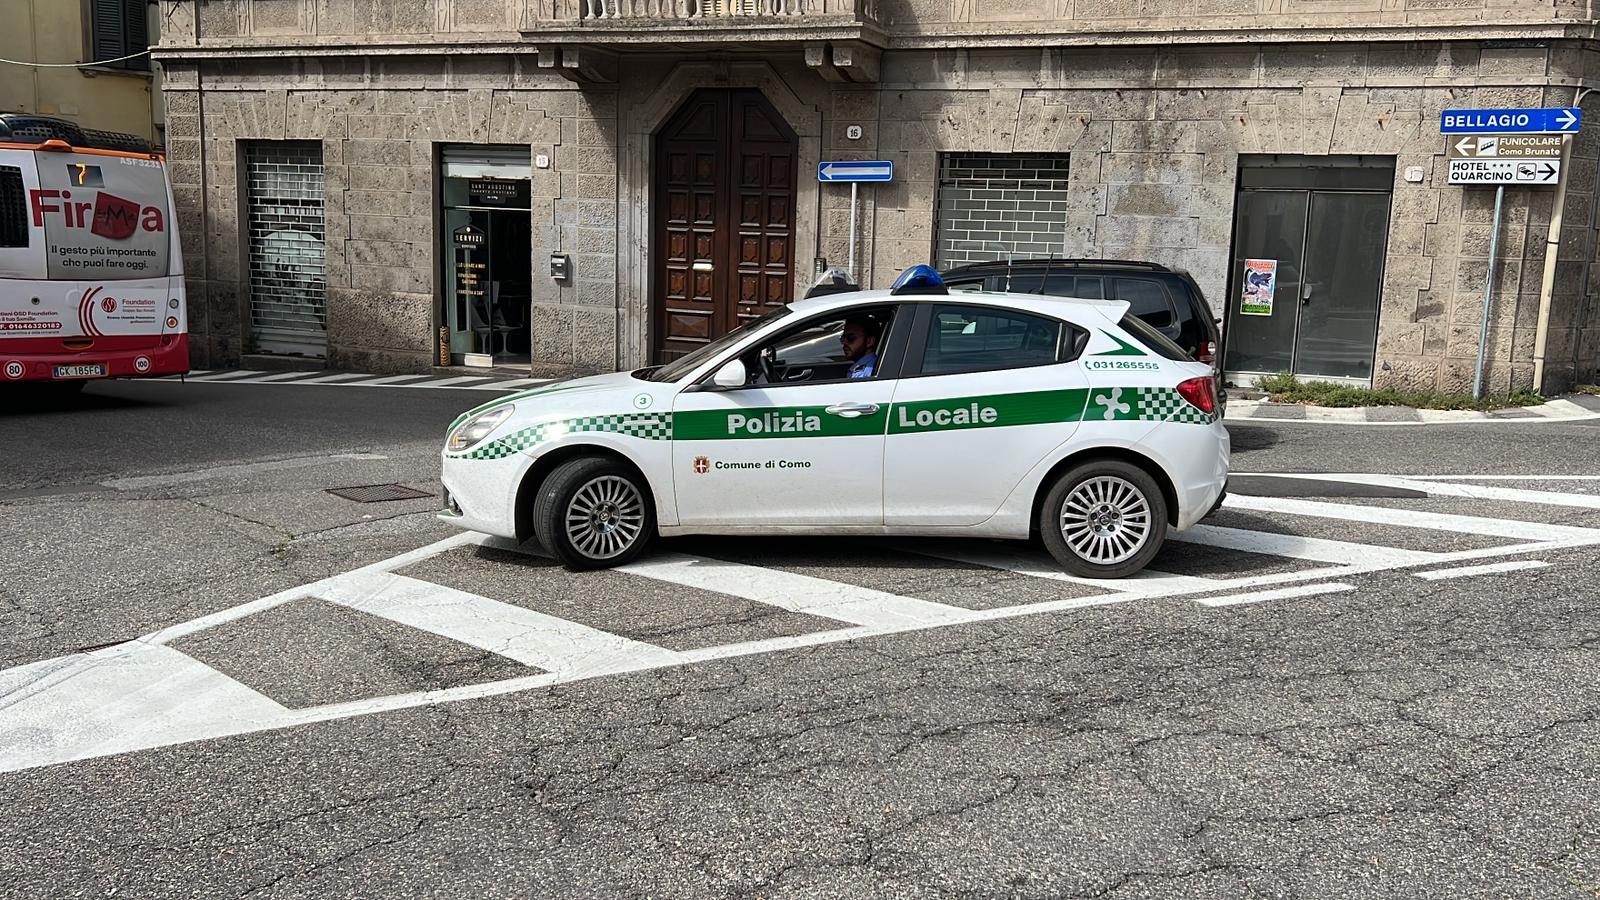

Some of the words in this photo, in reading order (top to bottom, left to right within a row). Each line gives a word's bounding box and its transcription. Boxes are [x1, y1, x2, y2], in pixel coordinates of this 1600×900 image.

[1444, 114, 1529, 128] BELLAGIO
[850, 128, 858, 137] 16
[1499, 137, 1561, 146] FUNICOLARE
[1499, 148, 1522, 156] Como
[1525, 148, 1561, 156] Brunate
[1452, 162, 1489, 171] HOTEL
[75, 163, 87, 185] 7
[1451, 172, 1513, 181] QUARCINO
[455, 234, 482, 243] SERVIZI
[51, 245, 58, 254] Il
[60, 246, 88, 256] gesto
[90, 246, 105, 257] più
[107, 245, 157, 257] importante
[62, 257, 81, 267] che
[83, 258, 105, 269] puoi
[106, 258, 125, 268] fare
[137, 359, 148, 369] 100
[1093, 361, 1160, 370] 031265555
[8, 364, 21, 375] 80
[58, 367, 71, 376] GK
[74, 366, 100, 376] 185FC
[639, 397, 647, 405] 3
[727, 411, 821, 434] Polizia
[898, 402, 998, 428] Locale
[714, 459, 761, 470] Comune
[764, 459, 776, 470] di
[778, 459, 811, 470] Como
